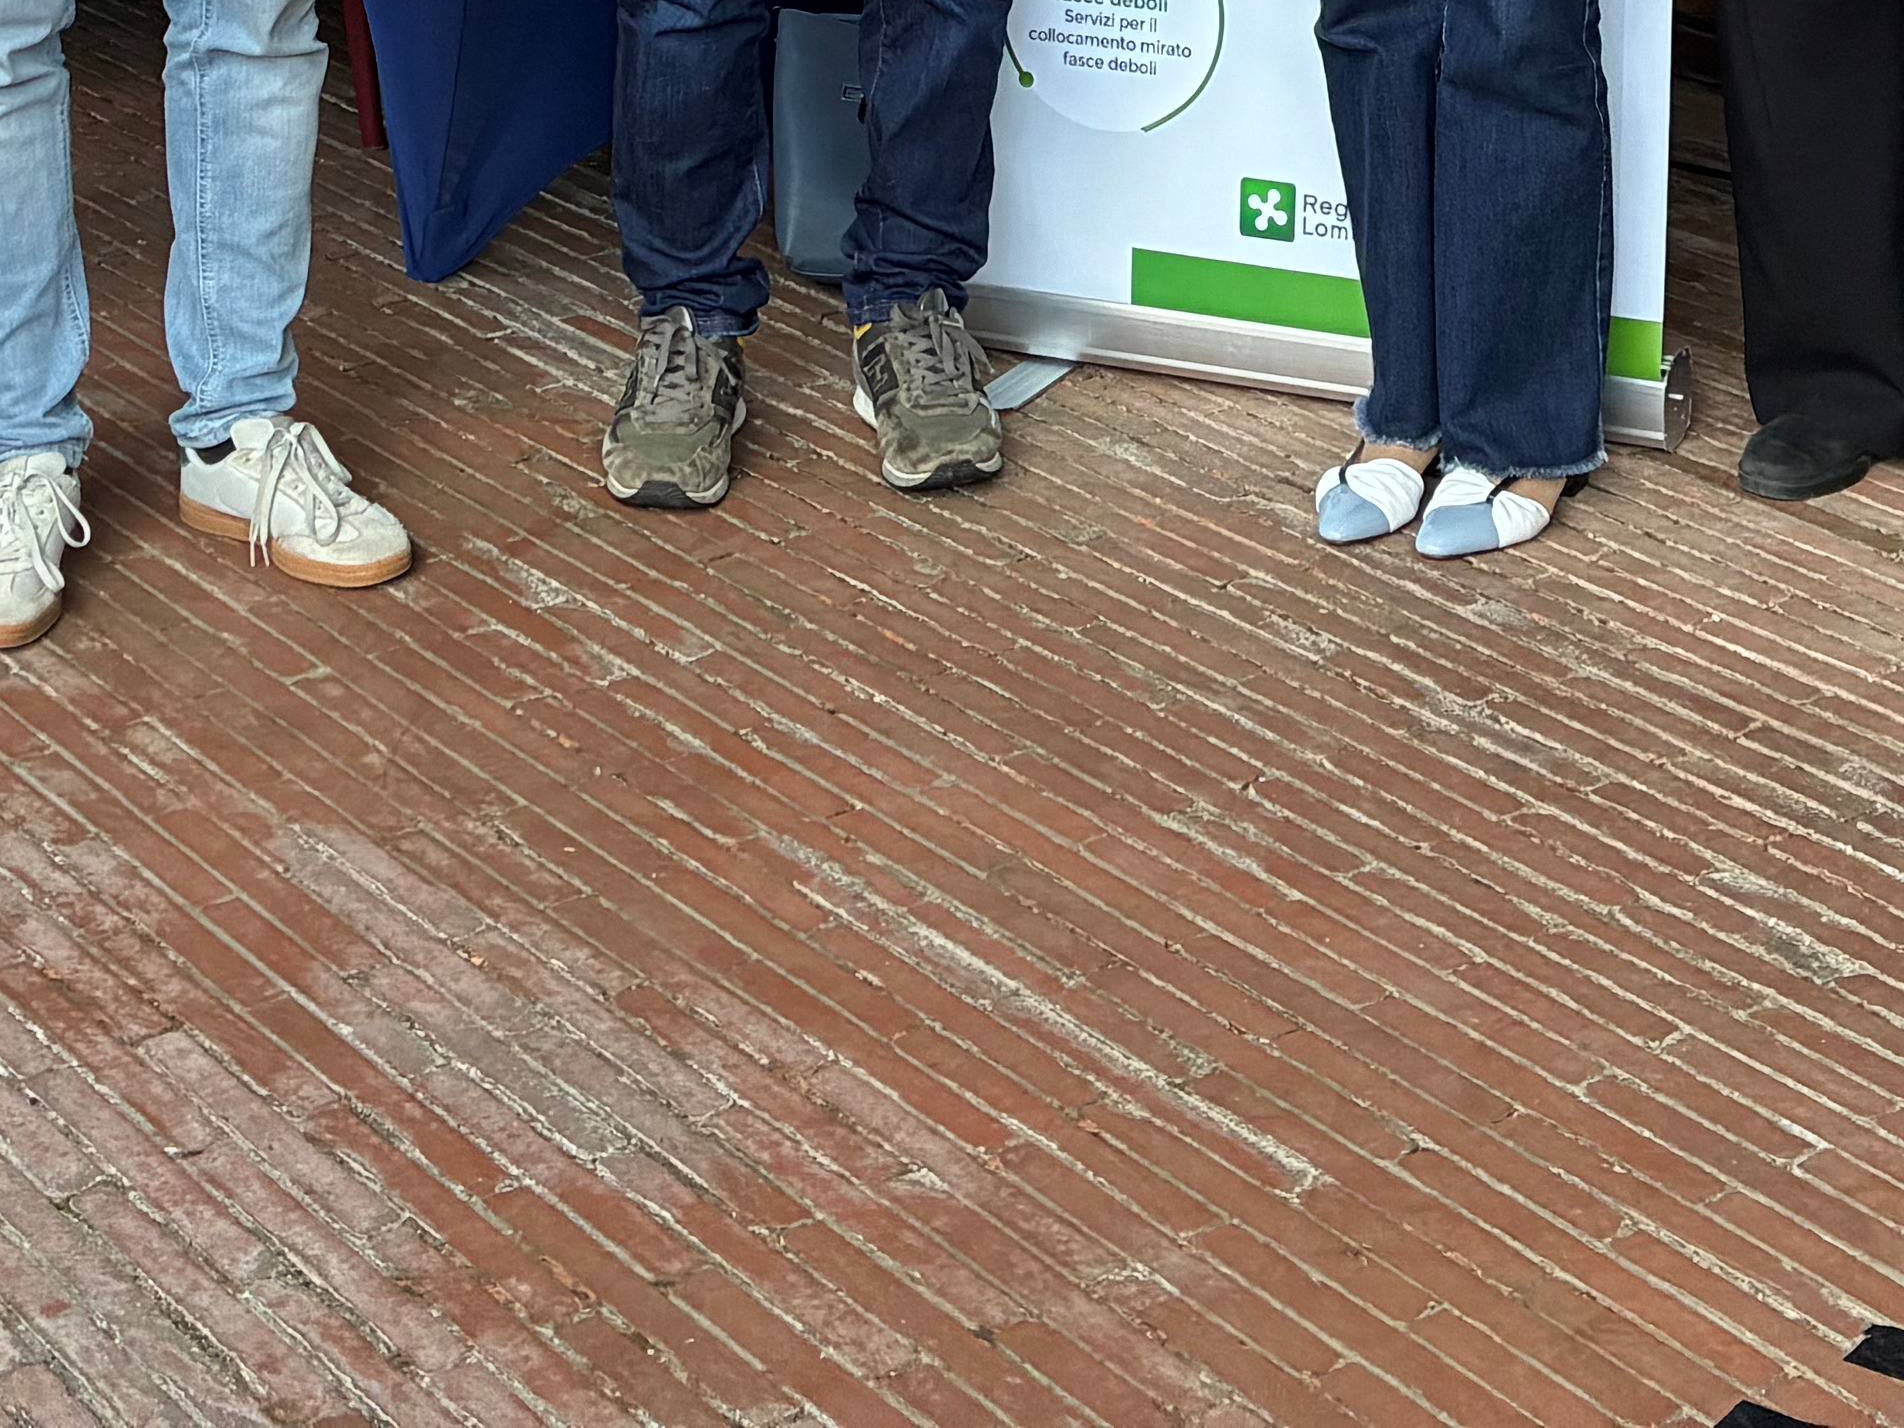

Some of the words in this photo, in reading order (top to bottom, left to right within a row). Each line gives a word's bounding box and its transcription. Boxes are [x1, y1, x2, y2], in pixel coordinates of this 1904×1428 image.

[1064, 9, 1115, 27] Servizi
[1119, 17, 1145, 32] per
[1149, 17, 1157, 33] il
[1028, 27, 1136, 52] collocamento
[1140, 40, 1192, 58] mirato
[1063, 51, 1104, 69] fasce
[1108, 56, 1157, 76] deboli
